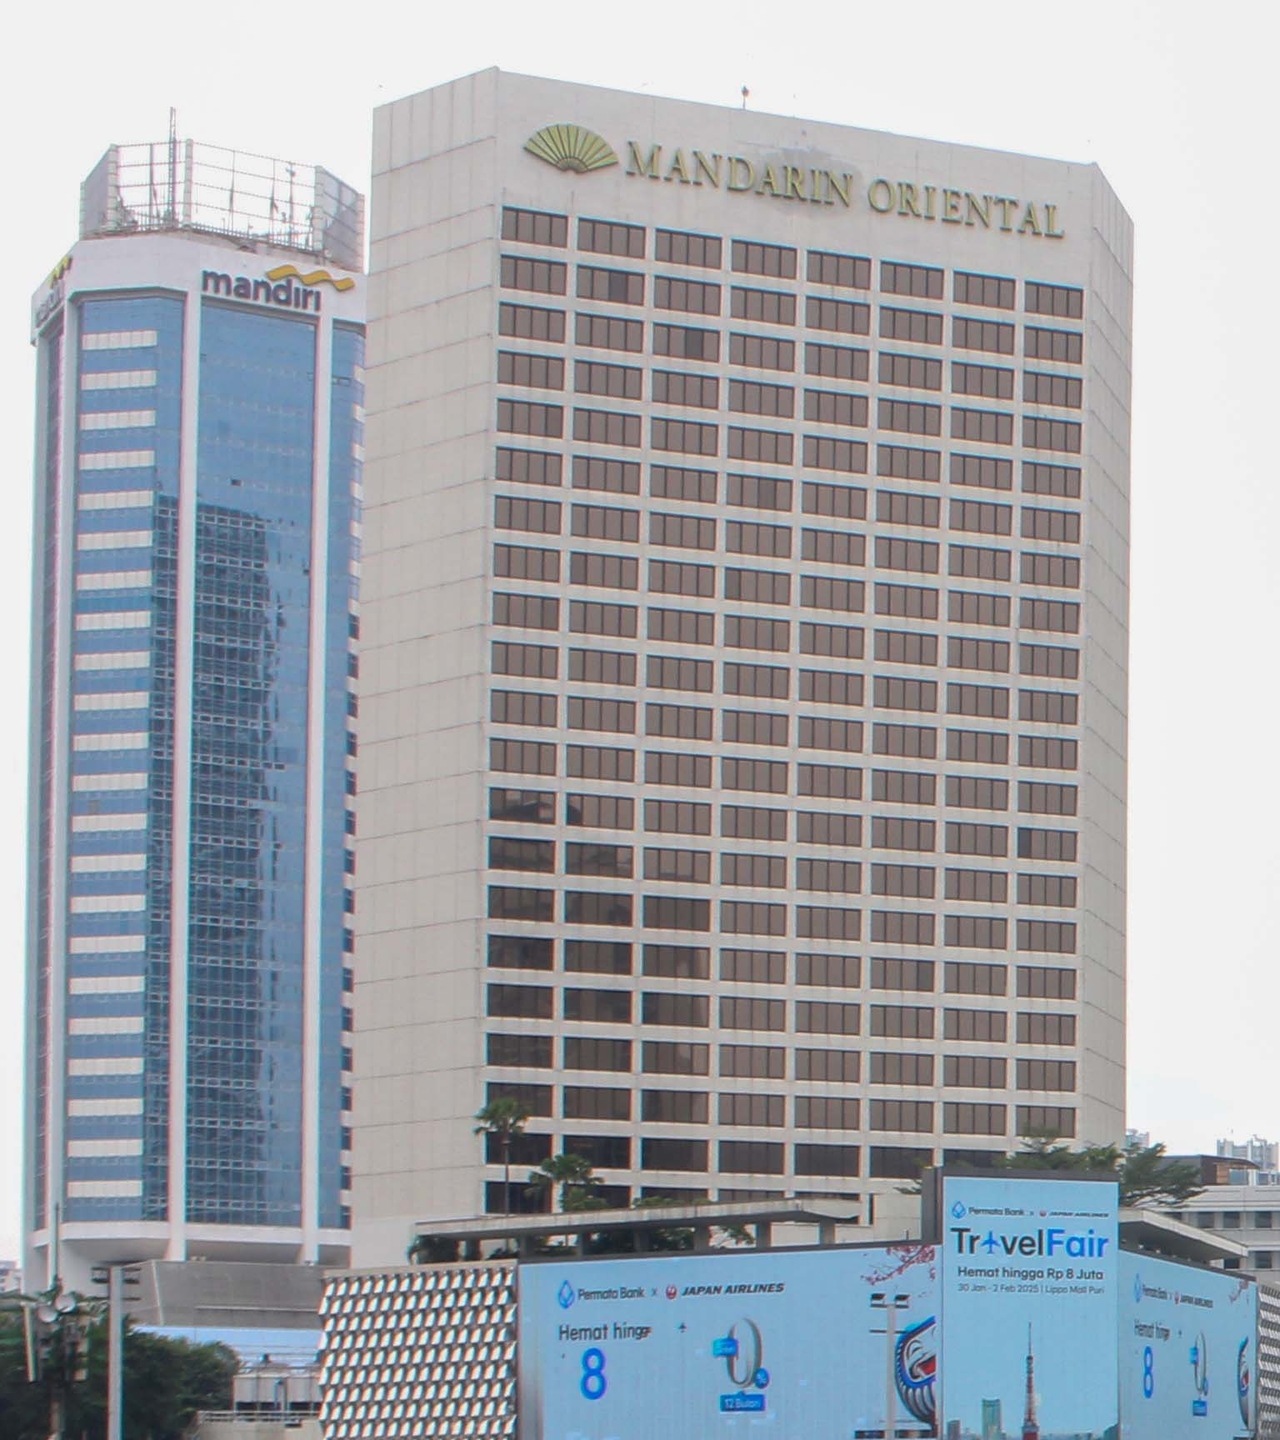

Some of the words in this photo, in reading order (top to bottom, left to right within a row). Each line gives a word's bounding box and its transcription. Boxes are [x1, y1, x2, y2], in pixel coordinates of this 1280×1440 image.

[625, 140, 853, 208] MANDARIN
[867, 177, 1065, 239] ORIENTAL
[202, 269, 321, 312] mandiri
[969, 1207, 1003, 1217] Permata
[1005, 1208, 1025, 1216] Bank
[958, 1266, 999, 1278] Hemat
[1002, 1266, 1044, 1281] hingga
[1047, 1268, 1064, 1280] Rp
[1066, 1268, 1074, 1279] 8
[1076, 1269, 1104, 1280] Juta
[578, 1288, 617, 1300] Permata
[620, 1287, 645, 1299] Bank
[682, 1285, 722, 1296] JAPAN
[725, 1283, 785, 1294] AIRLINES
[559, 1324, 608, 1341] Hemat
[580, 1347, 608, 1400] 8
